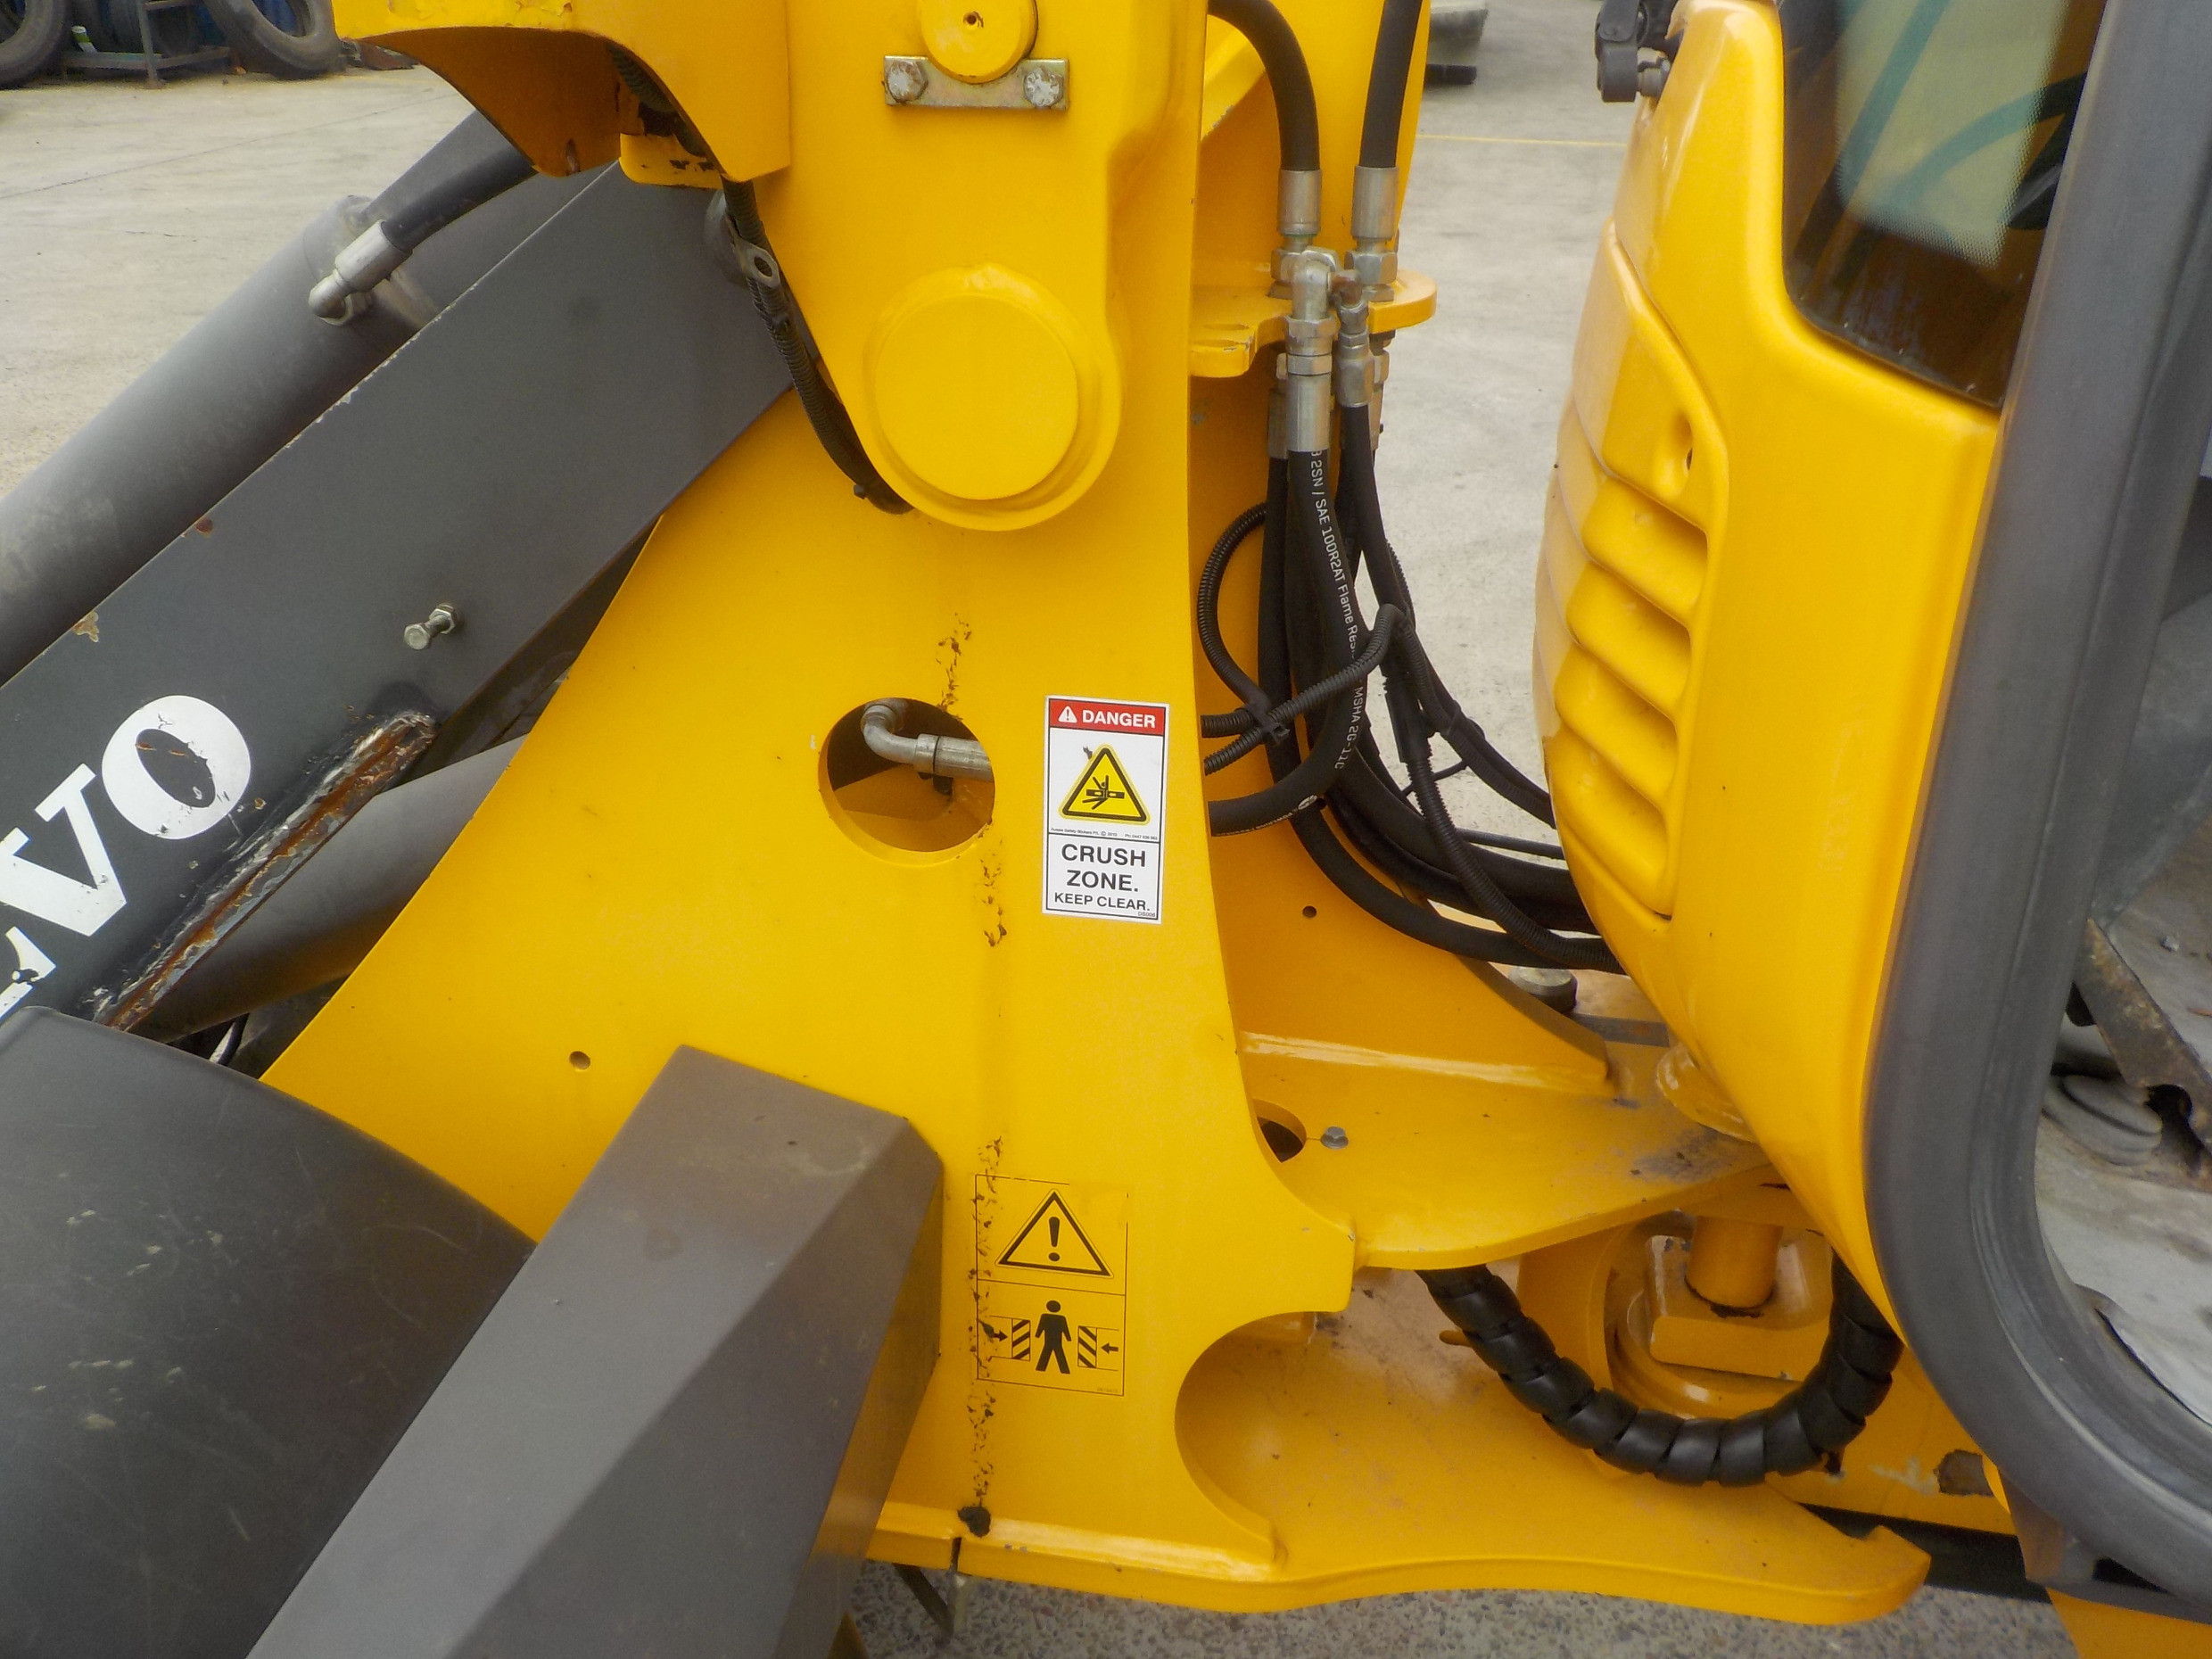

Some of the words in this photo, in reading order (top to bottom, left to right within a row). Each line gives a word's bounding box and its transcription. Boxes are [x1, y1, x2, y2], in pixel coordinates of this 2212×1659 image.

[1310, 459, 1324, 487] 2SN
[1316, 498, 1331, 525] SAE
[1322, 525, 1346, 582] 100R2AT
[1338, 583, 1355, 624] Flame
[1351, 686, 1364, 723] MSHA
[1081, 709, 1157, 729] DANGER
[1061, 843, 1146, 868] CRUSH
[1066, 869, 1139, 892] ZONE.
[1054, 892, 1094, 905] KEEP
[1096, 896, 1151, 911] CLEAR.
